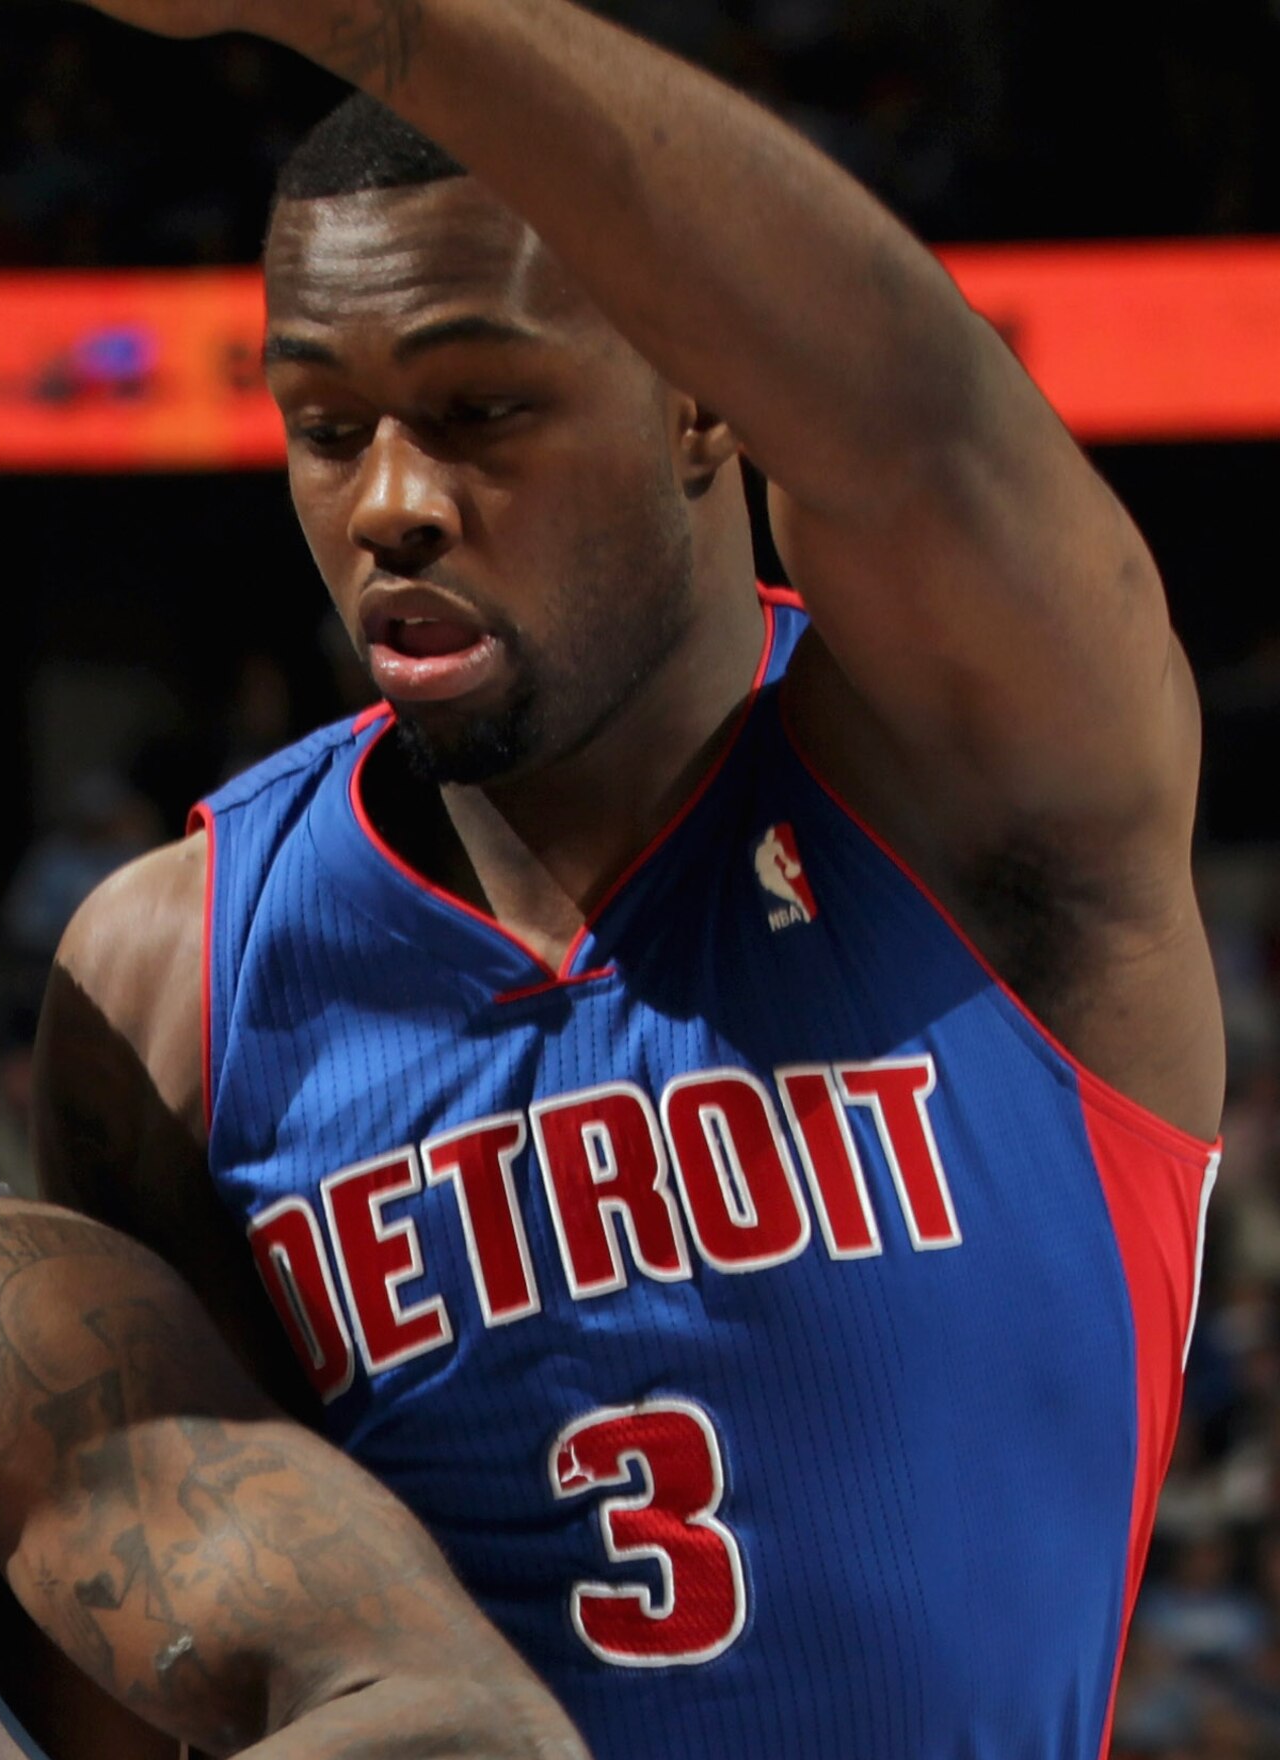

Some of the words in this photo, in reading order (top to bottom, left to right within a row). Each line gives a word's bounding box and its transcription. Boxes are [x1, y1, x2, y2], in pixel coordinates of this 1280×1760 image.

[768, 904, 802, 932] NBA
[249, 1054, 962, 1405] DETROIT
[549, 1398, 748, 1668] 3
